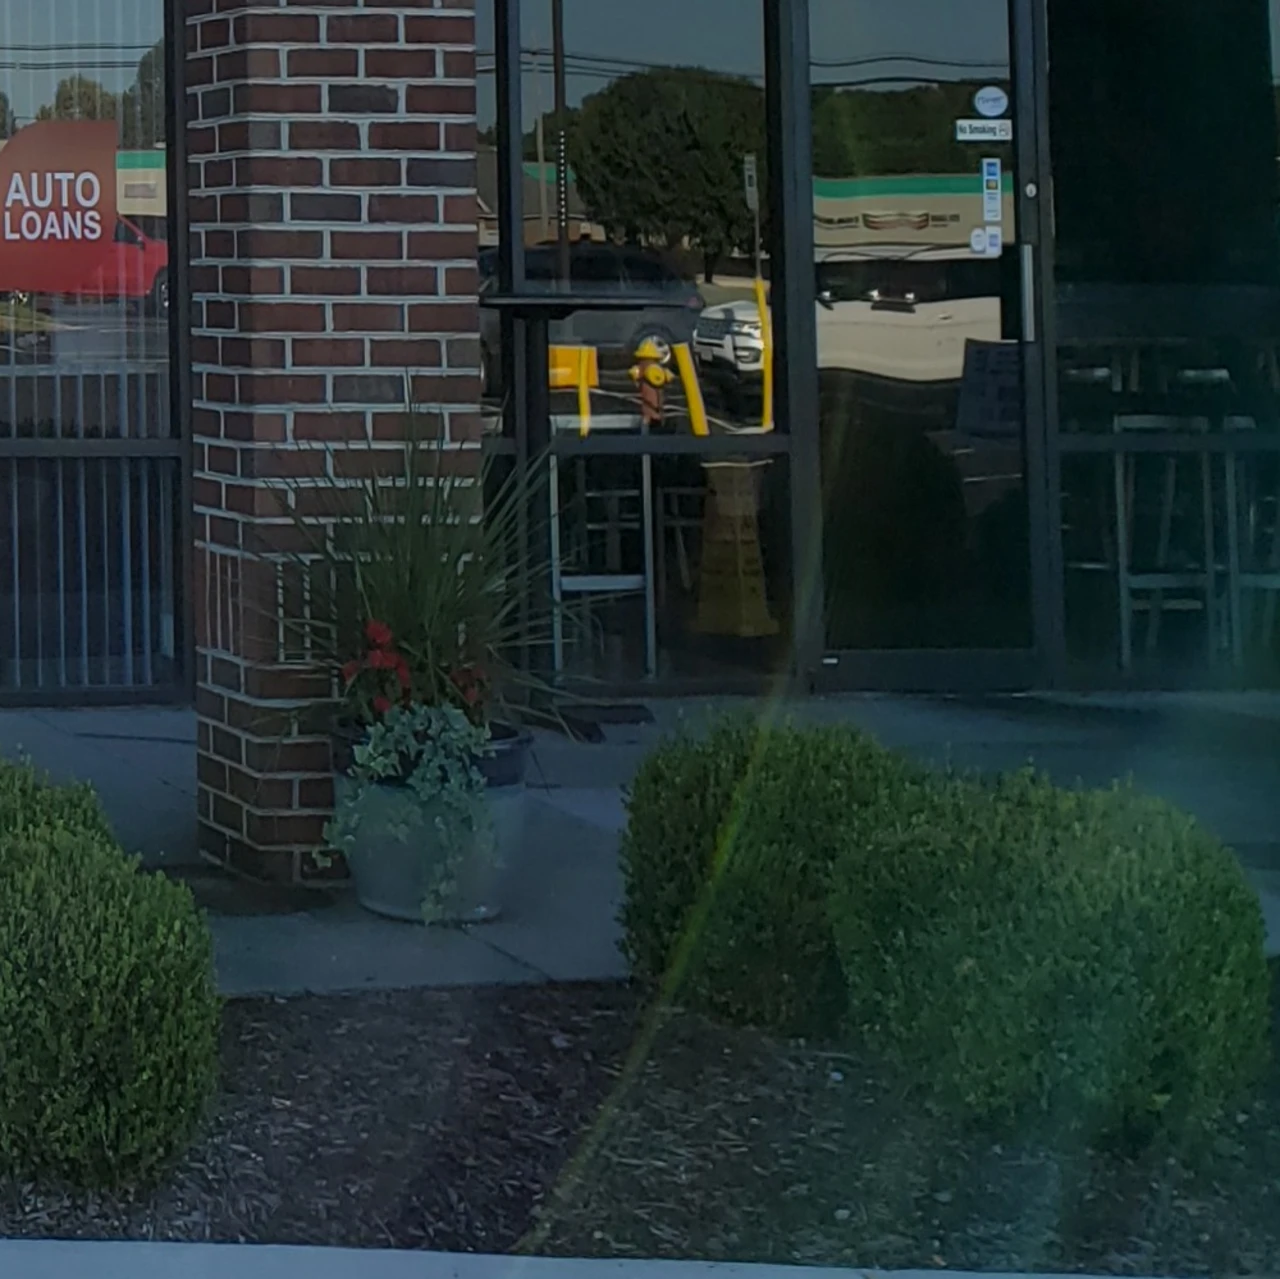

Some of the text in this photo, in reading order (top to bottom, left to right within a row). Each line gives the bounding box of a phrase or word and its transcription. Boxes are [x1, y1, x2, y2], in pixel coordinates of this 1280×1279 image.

[968, 124, 997, 137] Smoking
[5, 171, 101, 208] AUTO
[4, 210, 102, 240] LOANS
